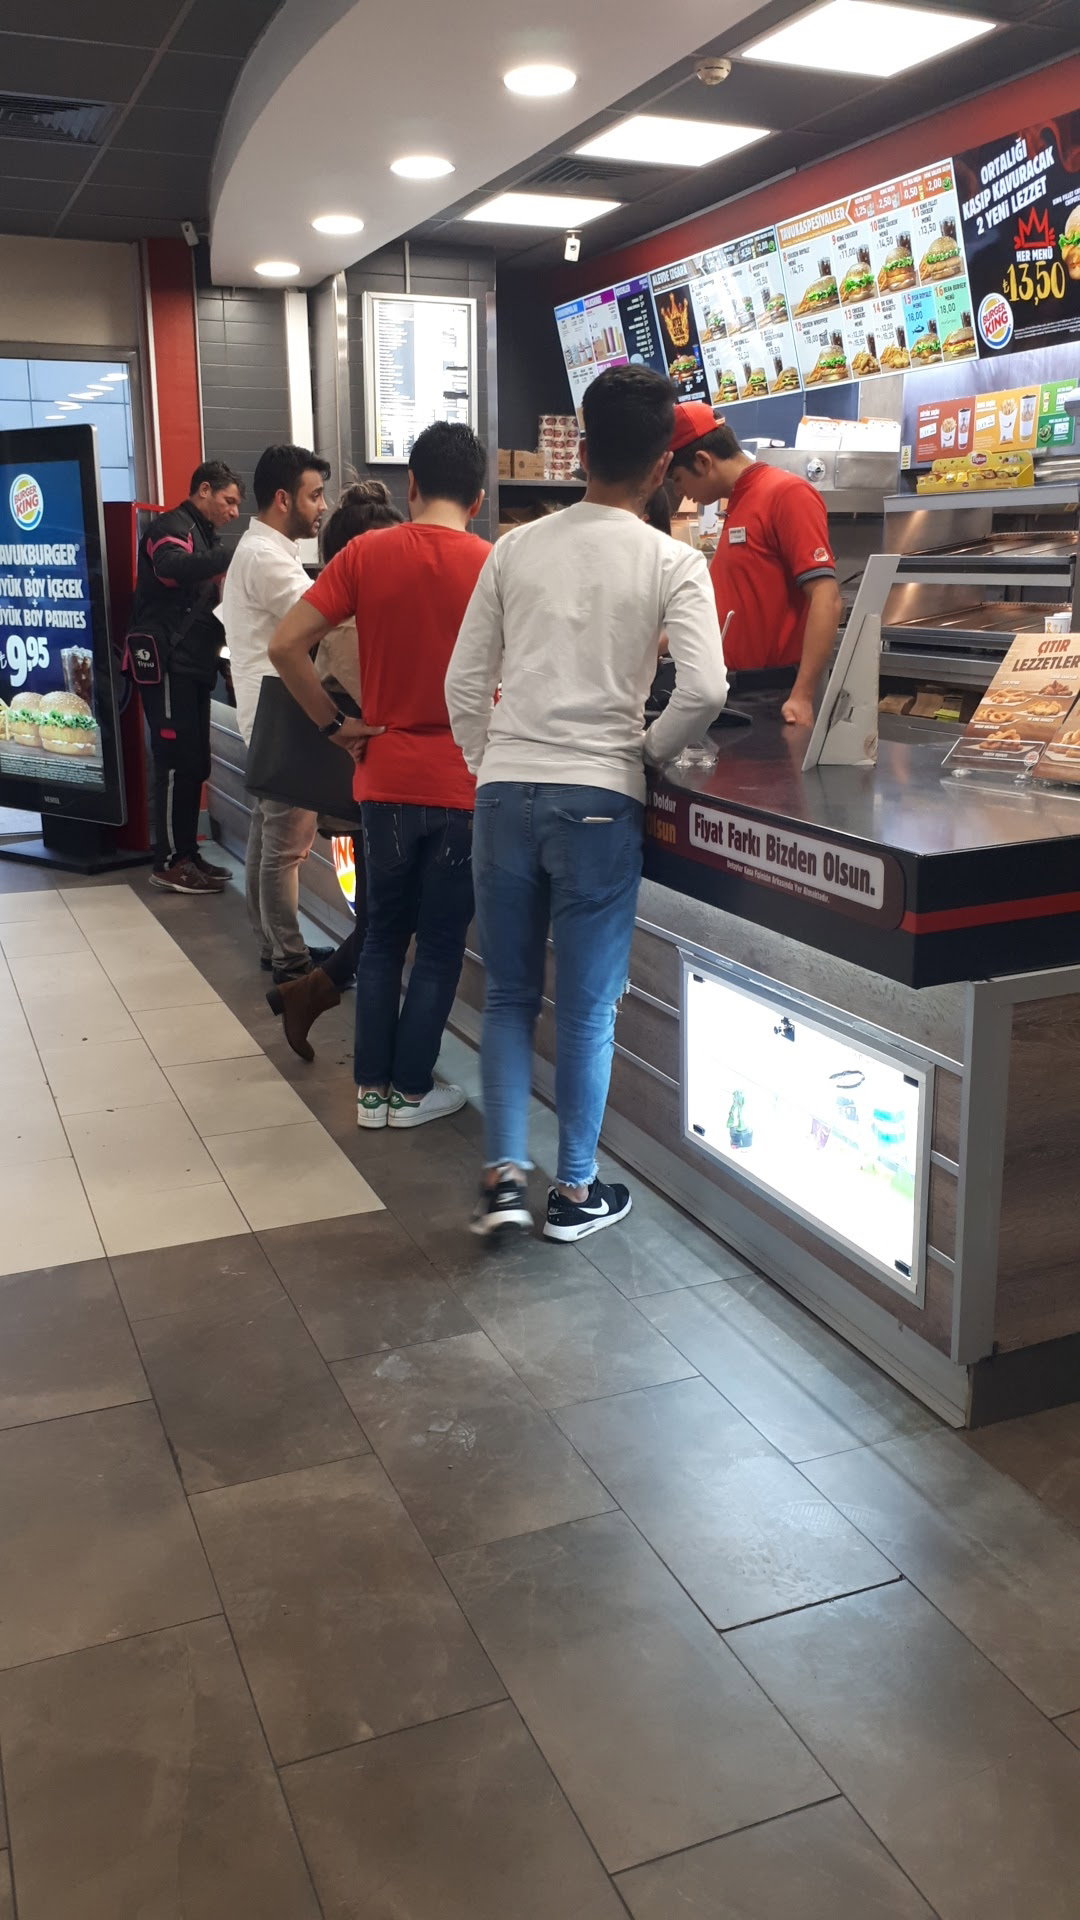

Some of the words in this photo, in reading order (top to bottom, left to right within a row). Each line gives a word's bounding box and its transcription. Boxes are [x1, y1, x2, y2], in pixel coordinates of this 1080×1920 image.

[980, 137, 1028, 185] ORTALIĞI
[962, 188, 991, 221] KASIP
[992, 146, 1055, 201] KAVURACAK
[912, 206, 920, 218] 11
[976, 216, 984, 235] 2
[1011, 175, 1047, 214] LEZZET
[1016, 250, 1031, 262] HER
[1032, 246, 1054, 261] MENÜ
[903, 294, 911, 305] 15
[935, 286, 944, 297] 16
[982, 302, 1006, 325] BURGER
[984, 311, 1009, 337] KING
[14, 485, 37, 504] BURGER
[15, 494, 39, 519] KING
[24, 578, 46, 597] BOY
[47, 575, 84, 602] İÇECEK
[23, 609, 43, 627] BOY
[45, 610, 87, 629] PATATES
[1037, 639, 1071, 656] ÇITIR
[1011, 654, 1080, 673] LEZZETLER
[653, 792, 676, 813] Doldur
[694, 812, 723, 845] Fiyat
[728, 822, 761, 857] Farkı
[766, 834, 817, 876] Bizden
[823, 851, 876, 896] Olsun.
